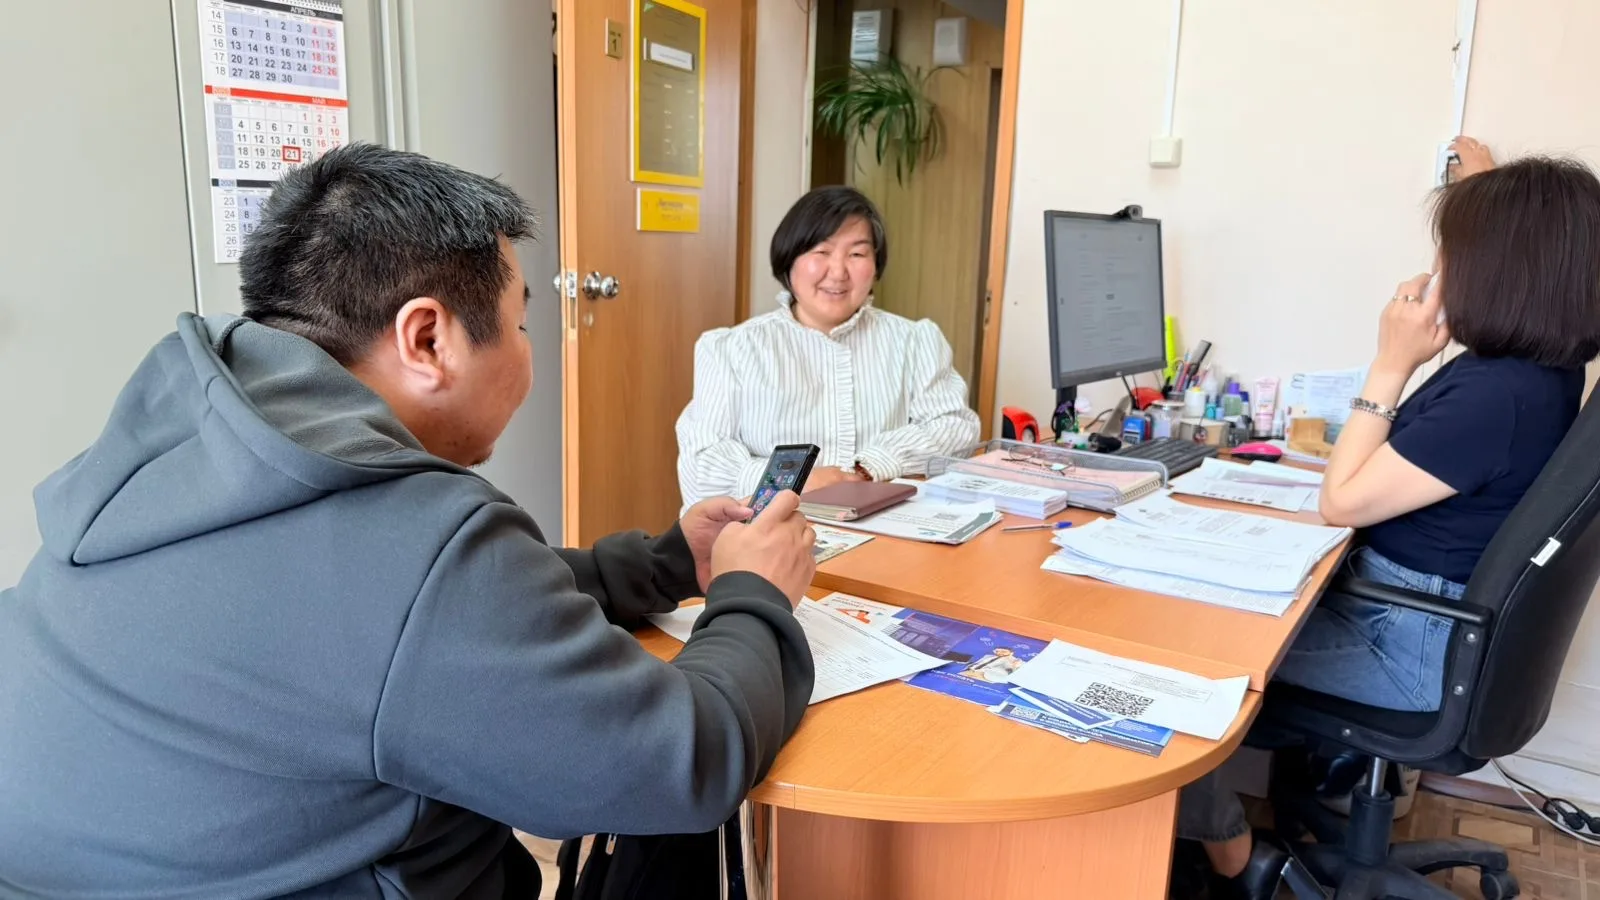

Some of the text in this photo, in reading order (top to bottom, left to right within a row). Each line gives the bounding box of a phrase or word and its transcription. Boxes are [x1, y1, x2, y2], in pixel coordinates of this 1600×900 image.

[290, 7, 316, 17] АПРЕЛЬ
[212, 10, 221, 19] 14
[265, 19, 269, 27] 1
[281, 22, 286, 30] 2
[297, 24, 302, 33] 3
[212, 25, 336, 51] 15 6 7 8 9 10 11 12
[214, 39, 224, 48] 16
[231, 41, 241, 50] 13
[248, 44, 258, 52] 14
[264, 46, 275, 55] 15
[281, 48, 291, 57] 16
[312, 52, 321, 61] 18
[612, 39, 617, 52] 1
[214, 52, 337, 76] 17 20 21 22 23 24 25 26
[216, 67, 292, 83] 18 27 28 29 30
[317, 115, 322, 123] 2
[238, 120, 244, 128] 4
[256, 122, 260, 130] 5
[271, 123, 277, 131] 6
[288, 124, 292, 132] 7
[304, 126, 308, 134] 8
[317, 127, 323, 135] 9
[331, 128, 340, 136] 10
[238, 134, 247, 142] 11
[255, 135, 264, 144] 12
[317, 140, 326, 148] 16
[238, 147, 248, 156] 18
[256, 148, 265, 156] 19
[271, 149, 281, 157] 20
[239, 160, 250, 169] 25
[256, 161, 266, 169] 26
[224, 197, 234, 206] 23
[244, 198, 248, 206] 1
[224, 210, 235, 219] 24
[225, 223, 236, 232] 25
[226, 237, 236, 245] 26
[227, 249, 236, 258] 27
